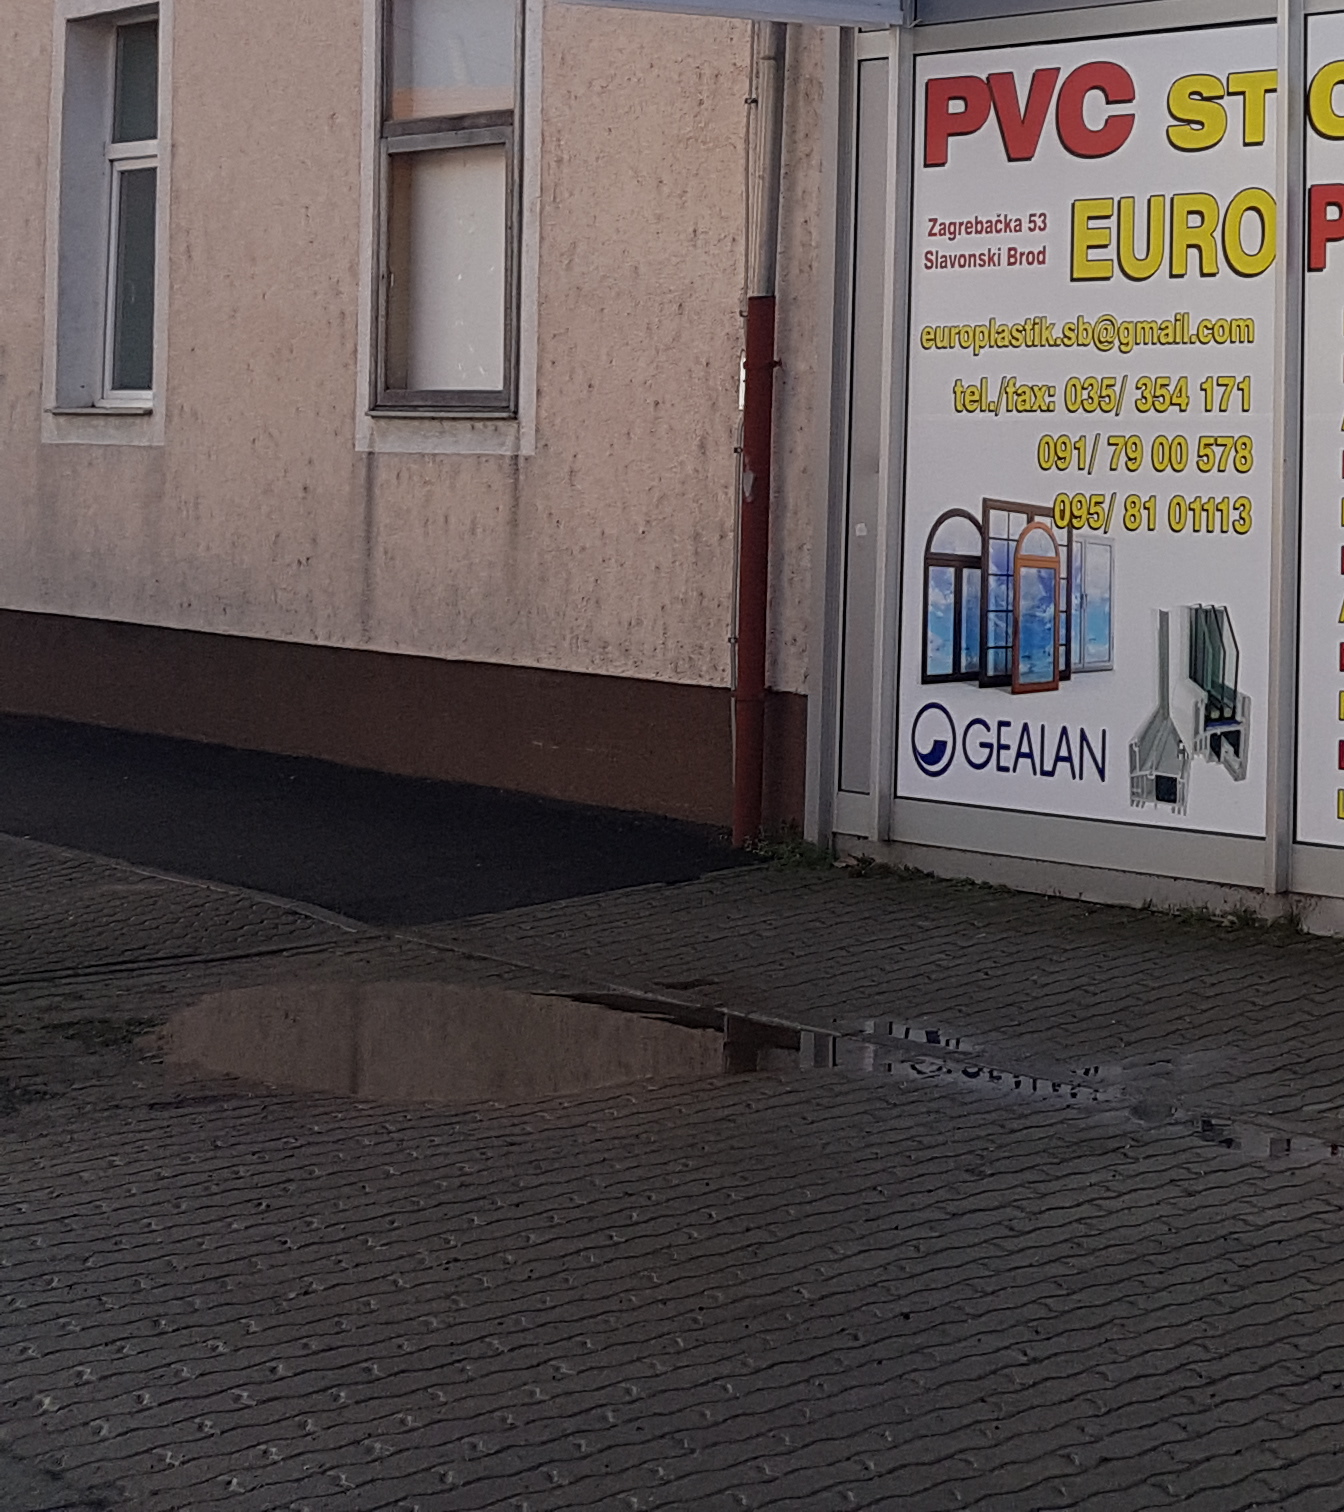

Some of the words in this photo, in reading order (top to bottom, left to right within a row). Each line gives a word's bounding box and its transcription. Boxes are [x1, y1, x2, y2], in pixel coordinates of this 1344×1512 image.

[923, 59, 1136, 168] PVC
[927, 214, 1023, 241] Zagrebačka
[1027, 212, 1048, 233] 53
[1070, 186, 1277, 282] EURO
[923, 247, 1003, 270] Slavonski
[1006, 245, 1047, 267] Brod
[920, 312, 1255, 356] europlastik.sb@gmail.com
[953, 375, 1056, 416] tel./fax:
[1064, 374, 1129, 416] 035/
[1135, 376, 1189, 413] 354
[1200, 376, 1251, 413] 171
[1037, 432, 1101, 475] 091/
[1107, 435, 1144, 472] 79
[1151, 435, 1189, 472] 00
[1196, 435, 1254, 473] 578
[1053, 492, 1117, 535] 095/
[1123, 494, 1157, 532] 81
[1168, 494, 1253, 535] 01113
[962, 717, 1107, 783] GEALAN
